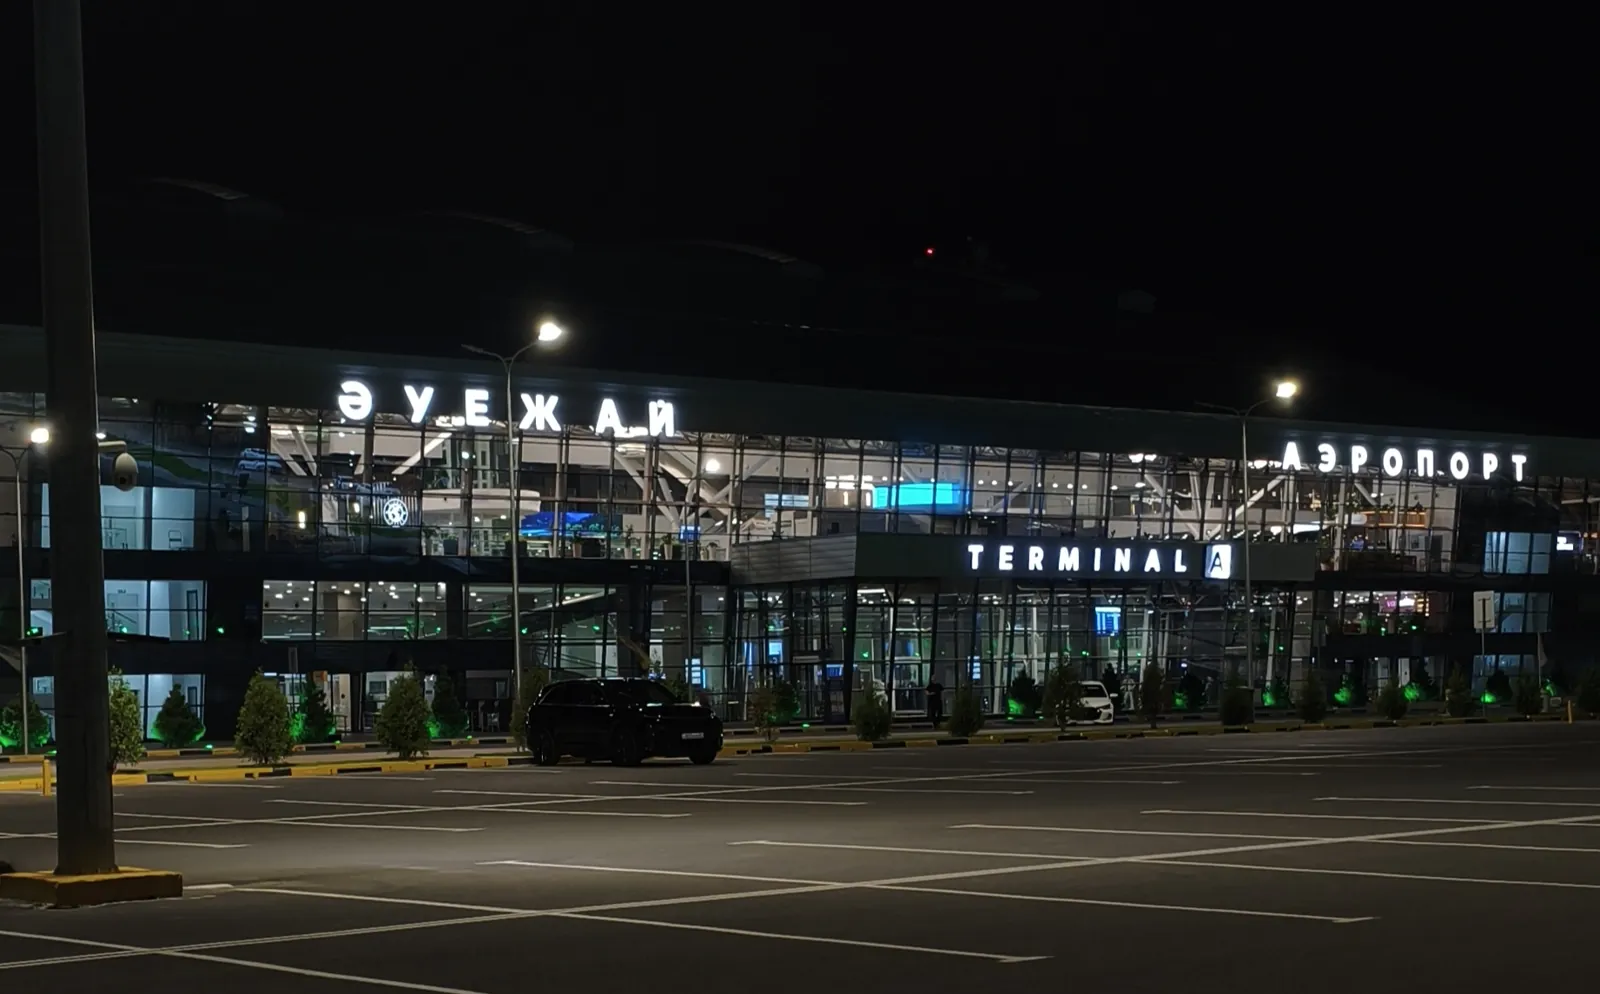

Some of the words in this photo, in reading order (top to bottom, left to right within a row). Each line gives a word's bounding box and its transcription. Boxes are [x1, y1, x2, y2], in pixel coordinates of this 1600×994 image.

[338, 380, 675, 437] ӘУЕЖАЙ
[1282, 441, 1527, 482] АЭРОПОРТ
[968, 544, 1187, 572] TERMINAL
